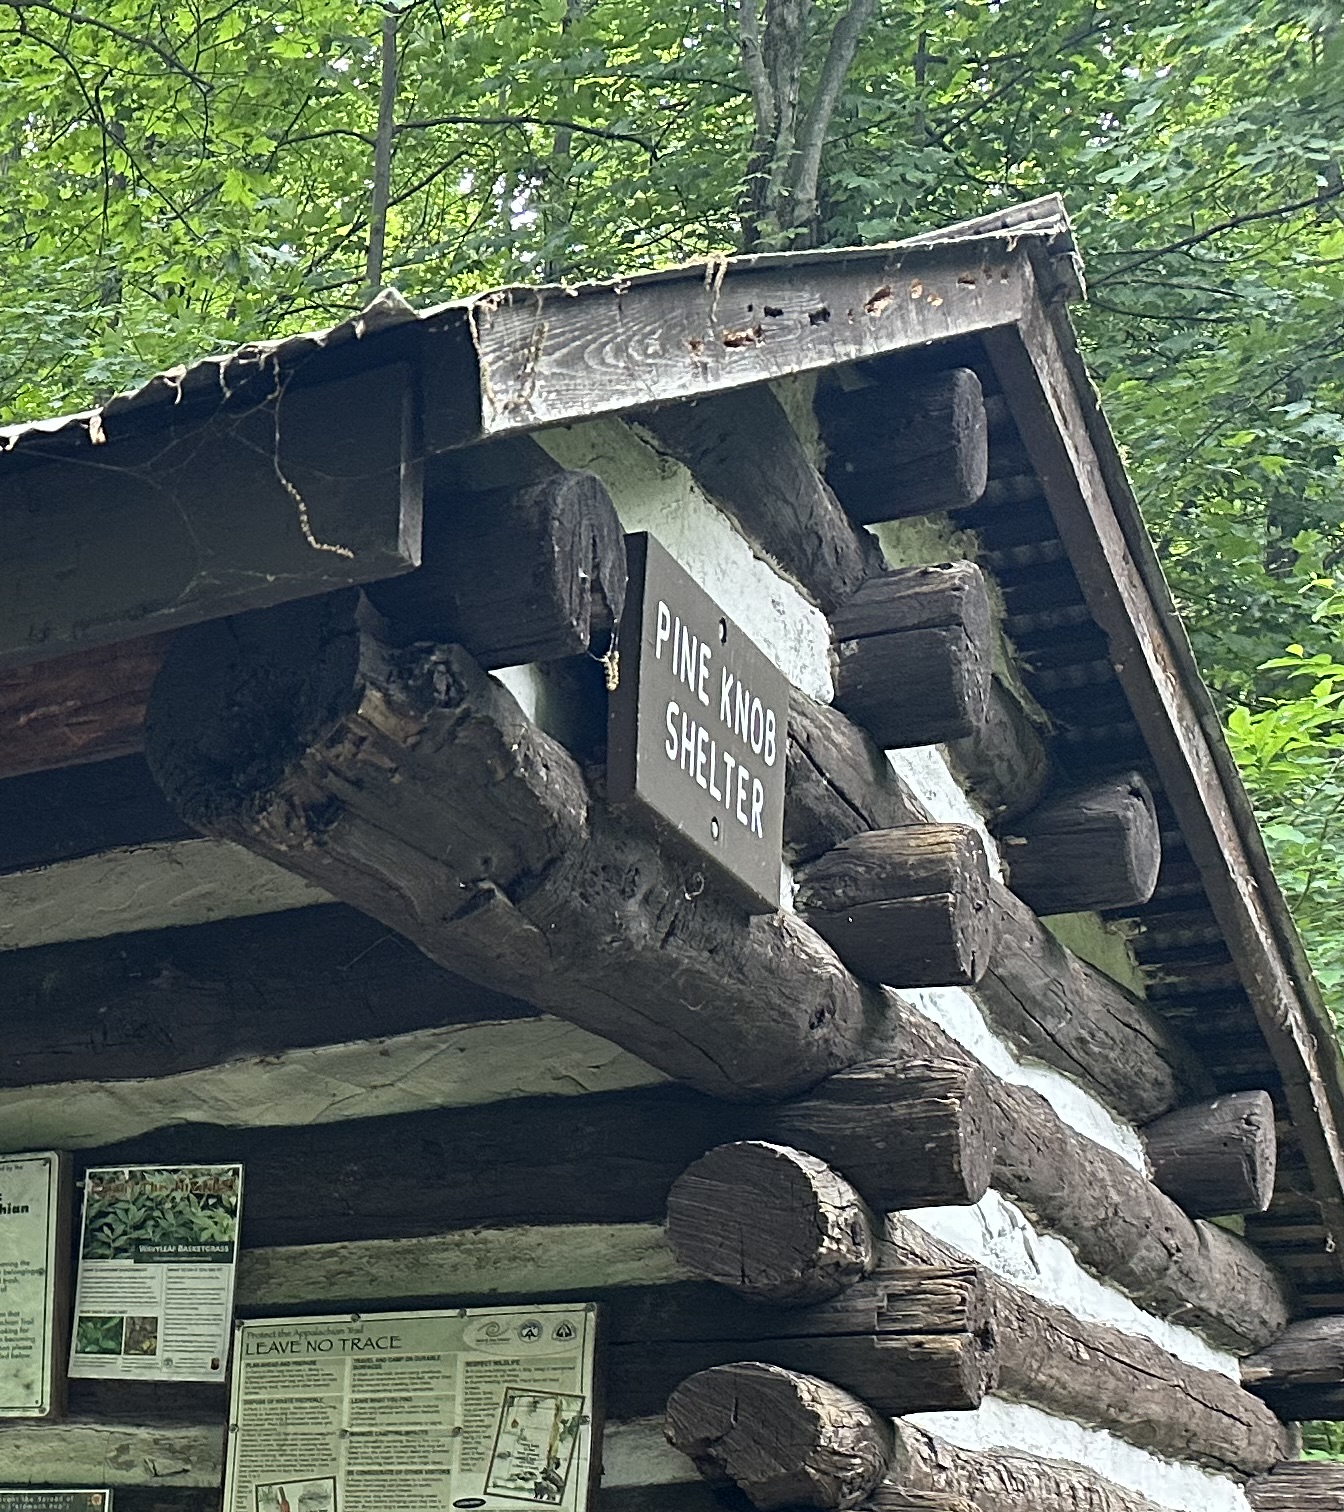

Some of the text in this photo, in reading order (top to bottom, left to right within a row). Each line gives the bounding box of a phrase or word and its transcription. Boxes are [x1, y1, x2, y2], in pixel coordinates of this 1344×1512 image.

[655, 600, 777, 767] PINE KNOB
[665, 700, 764, 839] SHELTER
[245, 1335, 402, 1355] LEAVE NO TRACE
[246, 1330, 276, 1339] Protect
